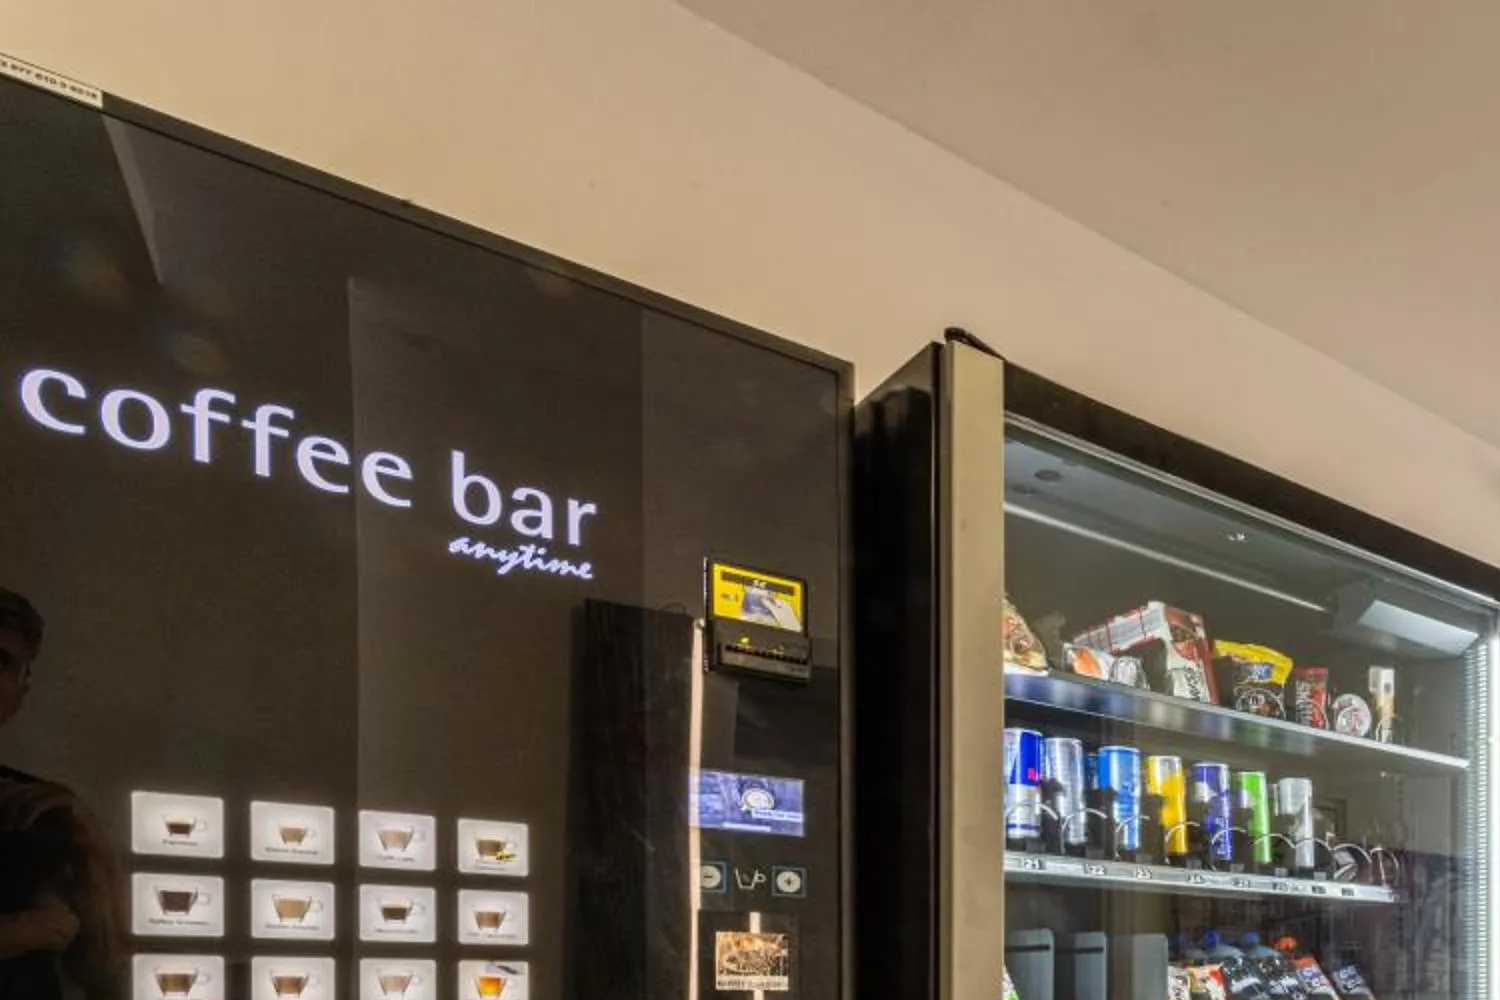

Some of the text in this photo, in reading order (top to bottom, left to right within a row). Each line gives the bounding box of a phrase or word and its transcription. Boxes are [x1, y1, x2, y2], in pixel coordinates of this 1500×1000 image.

[20, 367, 597, 547] coffee bar
[447, 536, 594, 580] anytime
